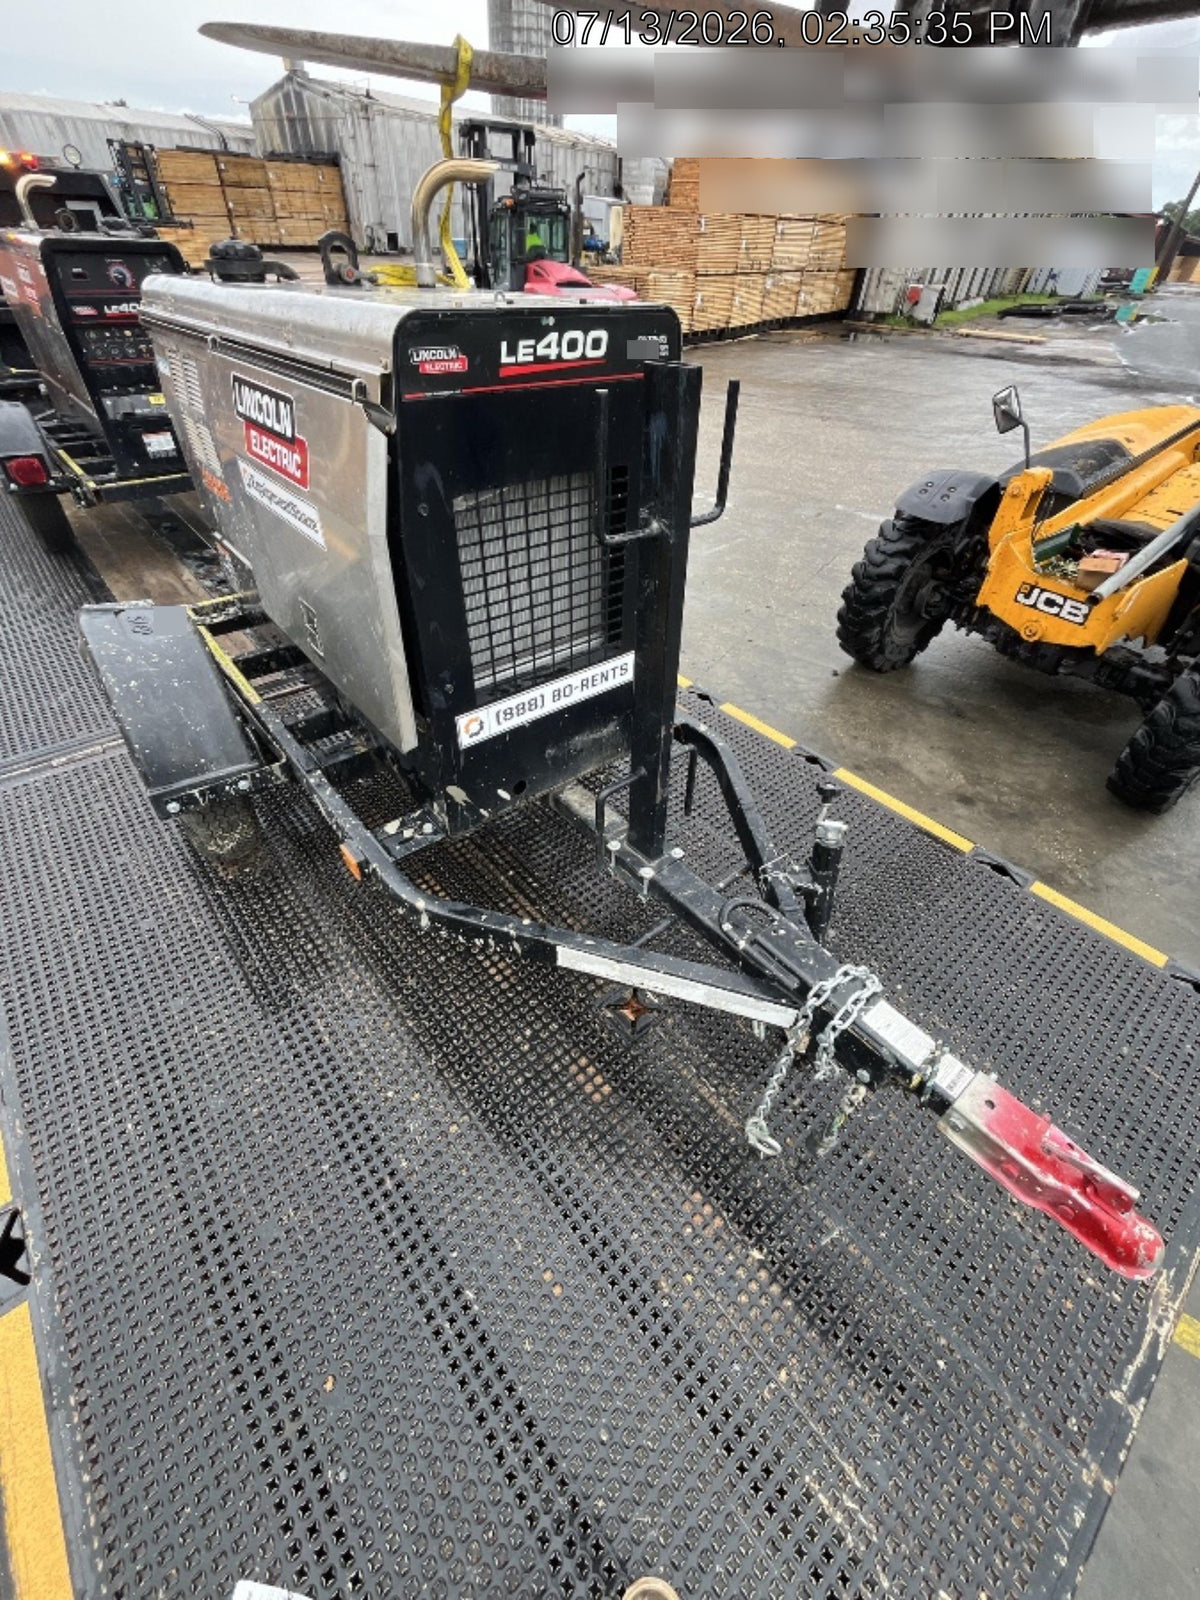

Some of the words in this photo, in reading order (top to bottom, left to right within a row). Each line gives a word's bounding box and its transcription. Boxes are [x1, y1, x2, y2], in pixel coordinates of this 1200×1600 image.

[412, 347, 458, 363] LINCOLN
[500, 329, 609, 364] LE400
[234, 381, 293, 439] LINCOLN
[250, 429, 302, 479] ELECTRIC
[1016, 587, 1090, 624] JCB
[494, 694, 546, 726] (888)
